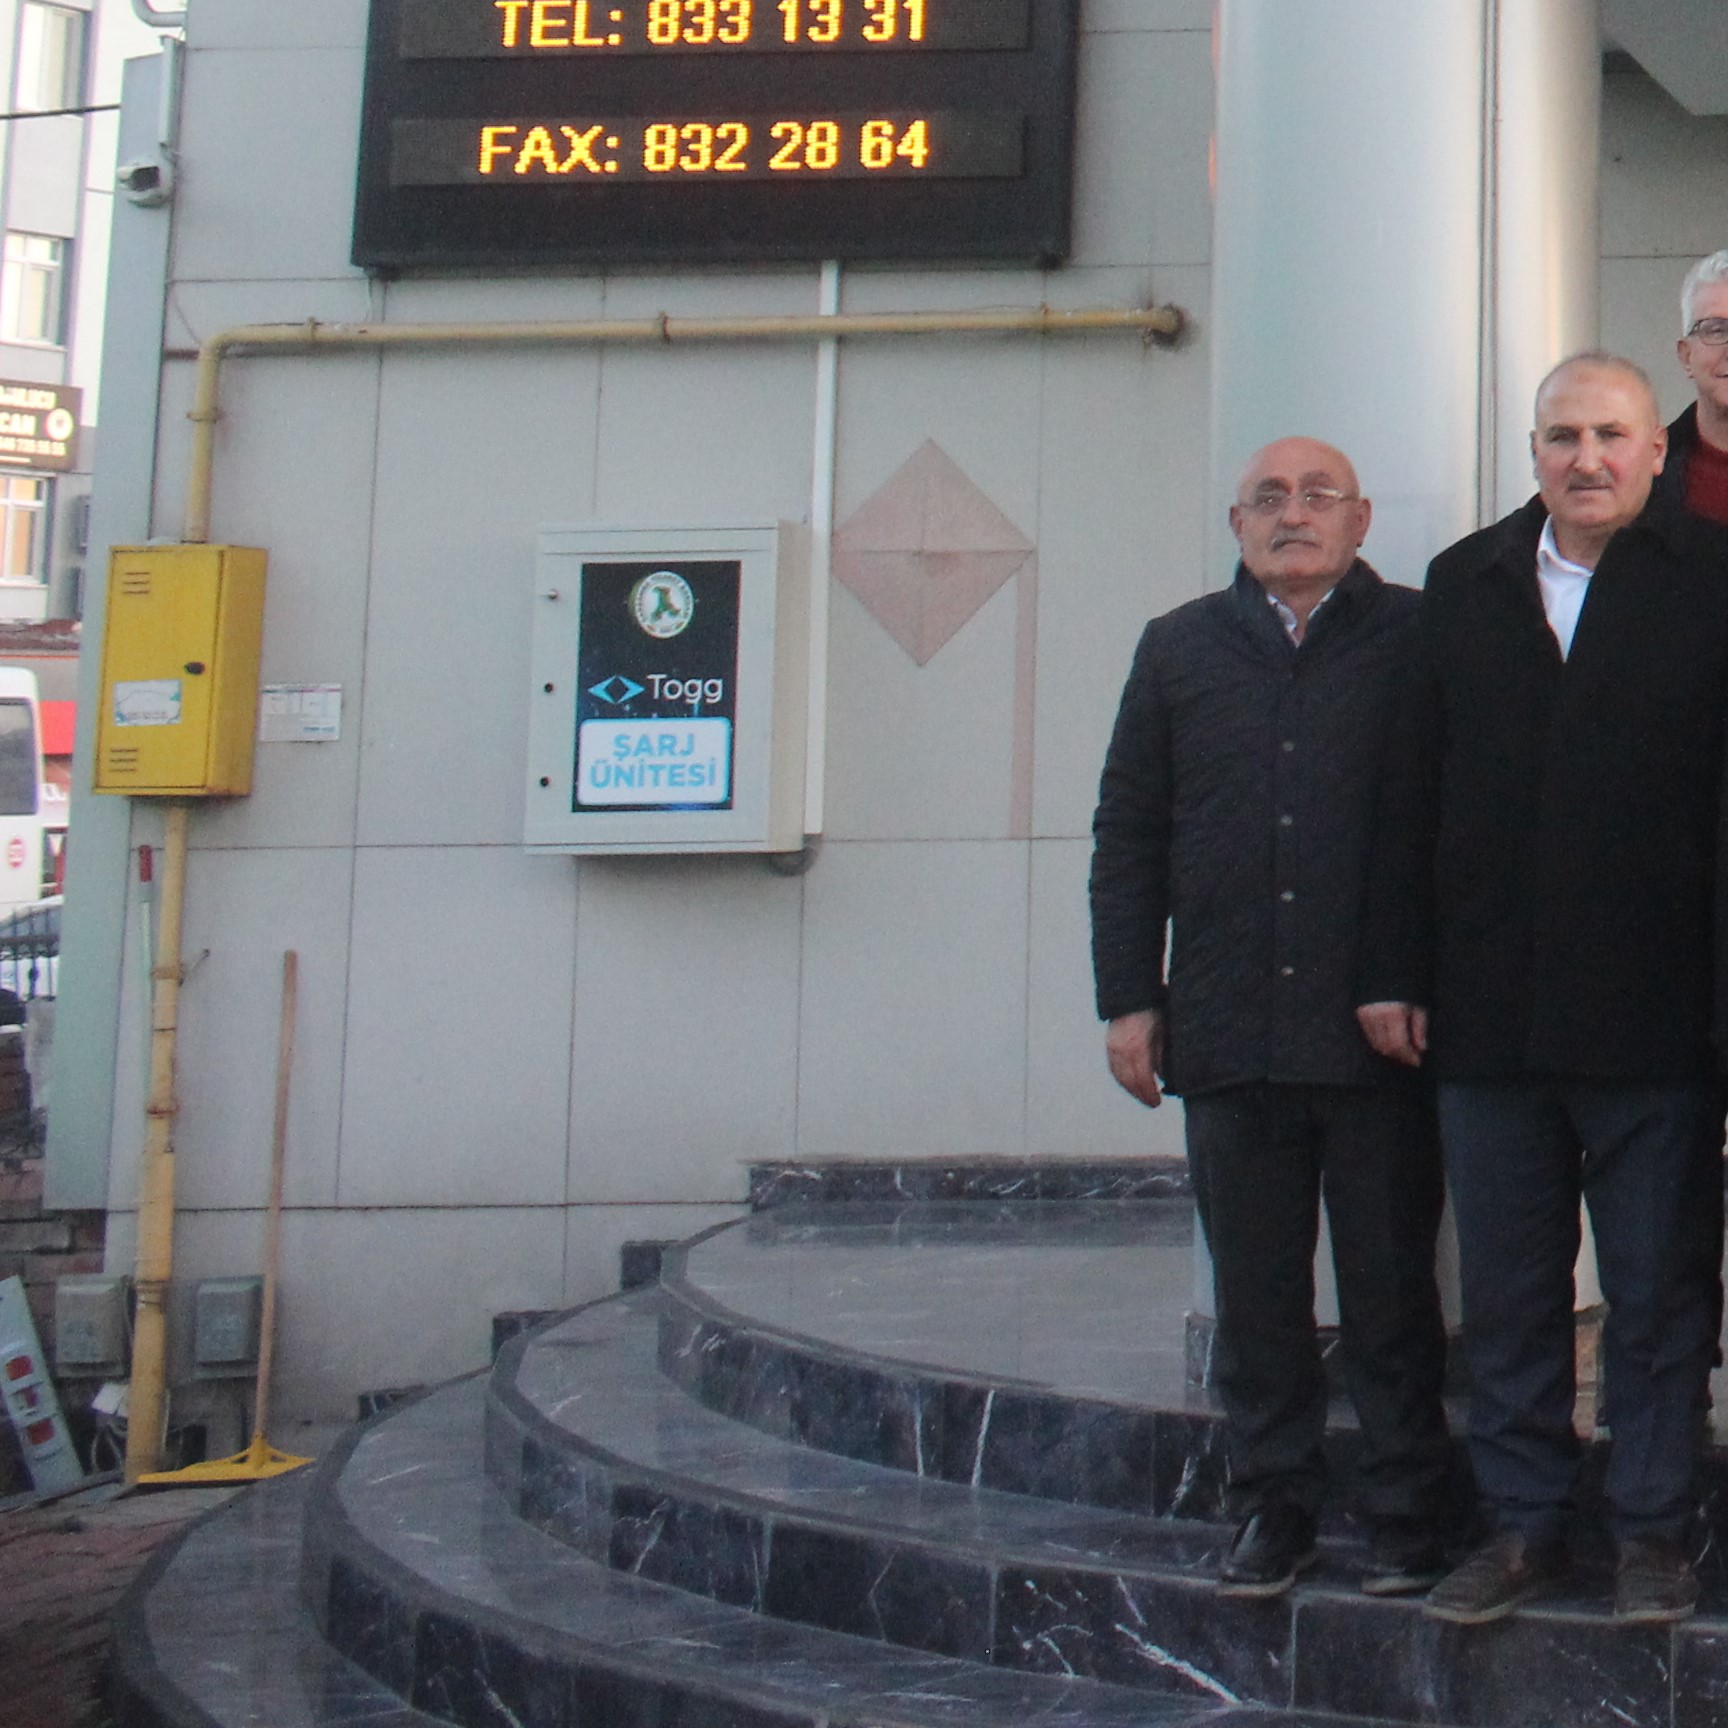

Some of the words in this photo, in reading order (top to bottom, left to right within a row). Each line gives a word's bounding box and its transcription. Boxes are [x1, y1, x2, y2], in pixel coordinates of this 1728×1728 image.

[494, 0, 622, 48] TEL:
[478, 125, 619, 174] FAX:
[643, 122, 749, 172] 832
[768, 121, 840, 171] 28
[860, 119, 930, 169] 64
[647, 673, 724, 704] Togg
[612, 733, 695, 759] ŞARJ
[589, 757, 716, 789] ÜNİTESİ
